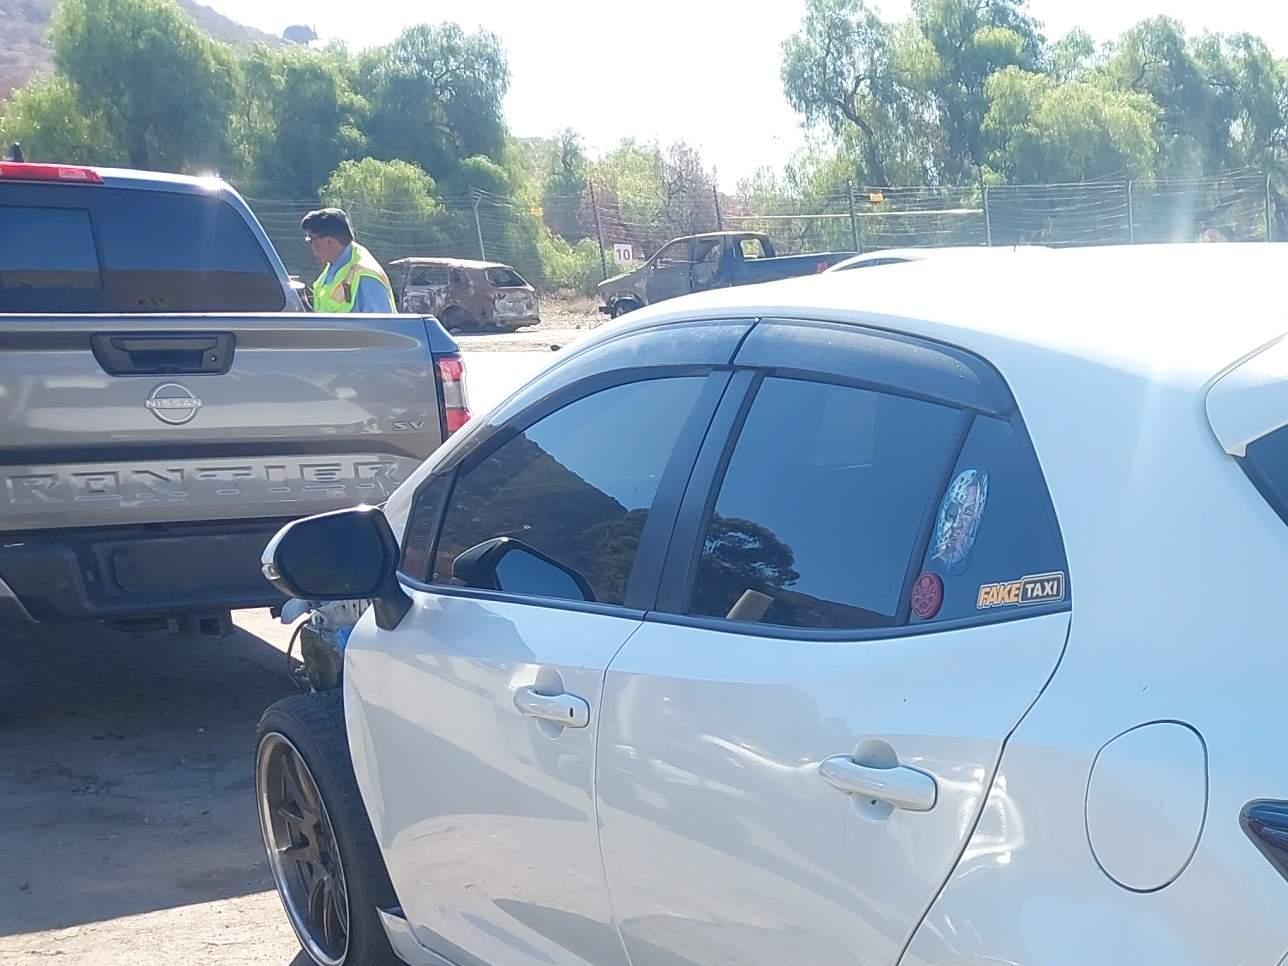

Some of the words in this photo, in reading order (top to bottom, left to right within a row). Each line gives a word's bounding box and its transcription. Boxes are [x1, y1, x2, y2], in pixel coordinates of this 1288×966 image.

[616, 249, 631, 261] 10
[145, 399, 202, 408] NISSAN
[391, 420, 424, 431] SV
[979, 583, 1021, 607] FAKE
[1025, 580, 1058, 599] TAXI
